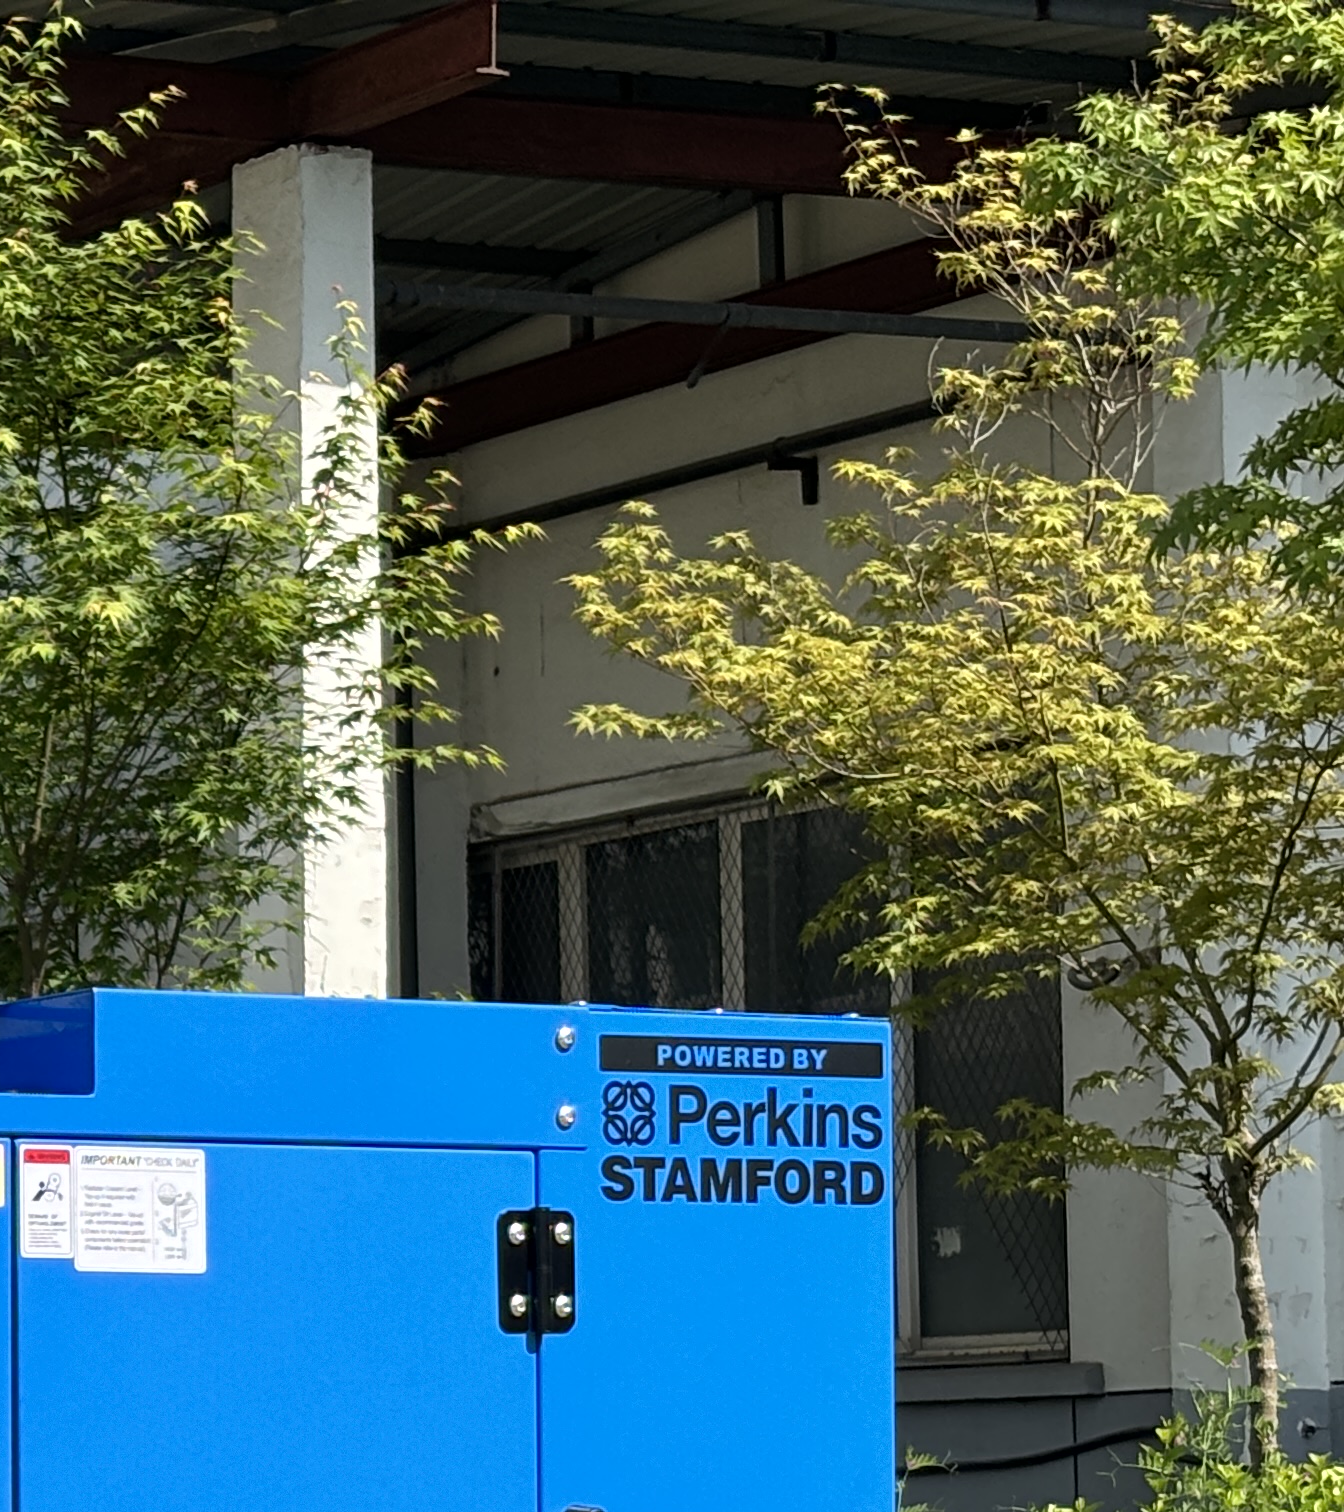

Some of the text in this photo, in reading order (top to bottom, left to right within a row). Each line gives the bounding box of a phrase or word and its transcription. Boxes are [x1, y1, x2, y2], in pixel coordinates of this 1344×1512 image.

[657, 1045, 828, 1070] POWERED BY
[668, 1084, 883, 1149] Perkins
[80, 1155, 143, 1167] IMPORTANT
[600, 1155, 885, 1206] STAMFORD
